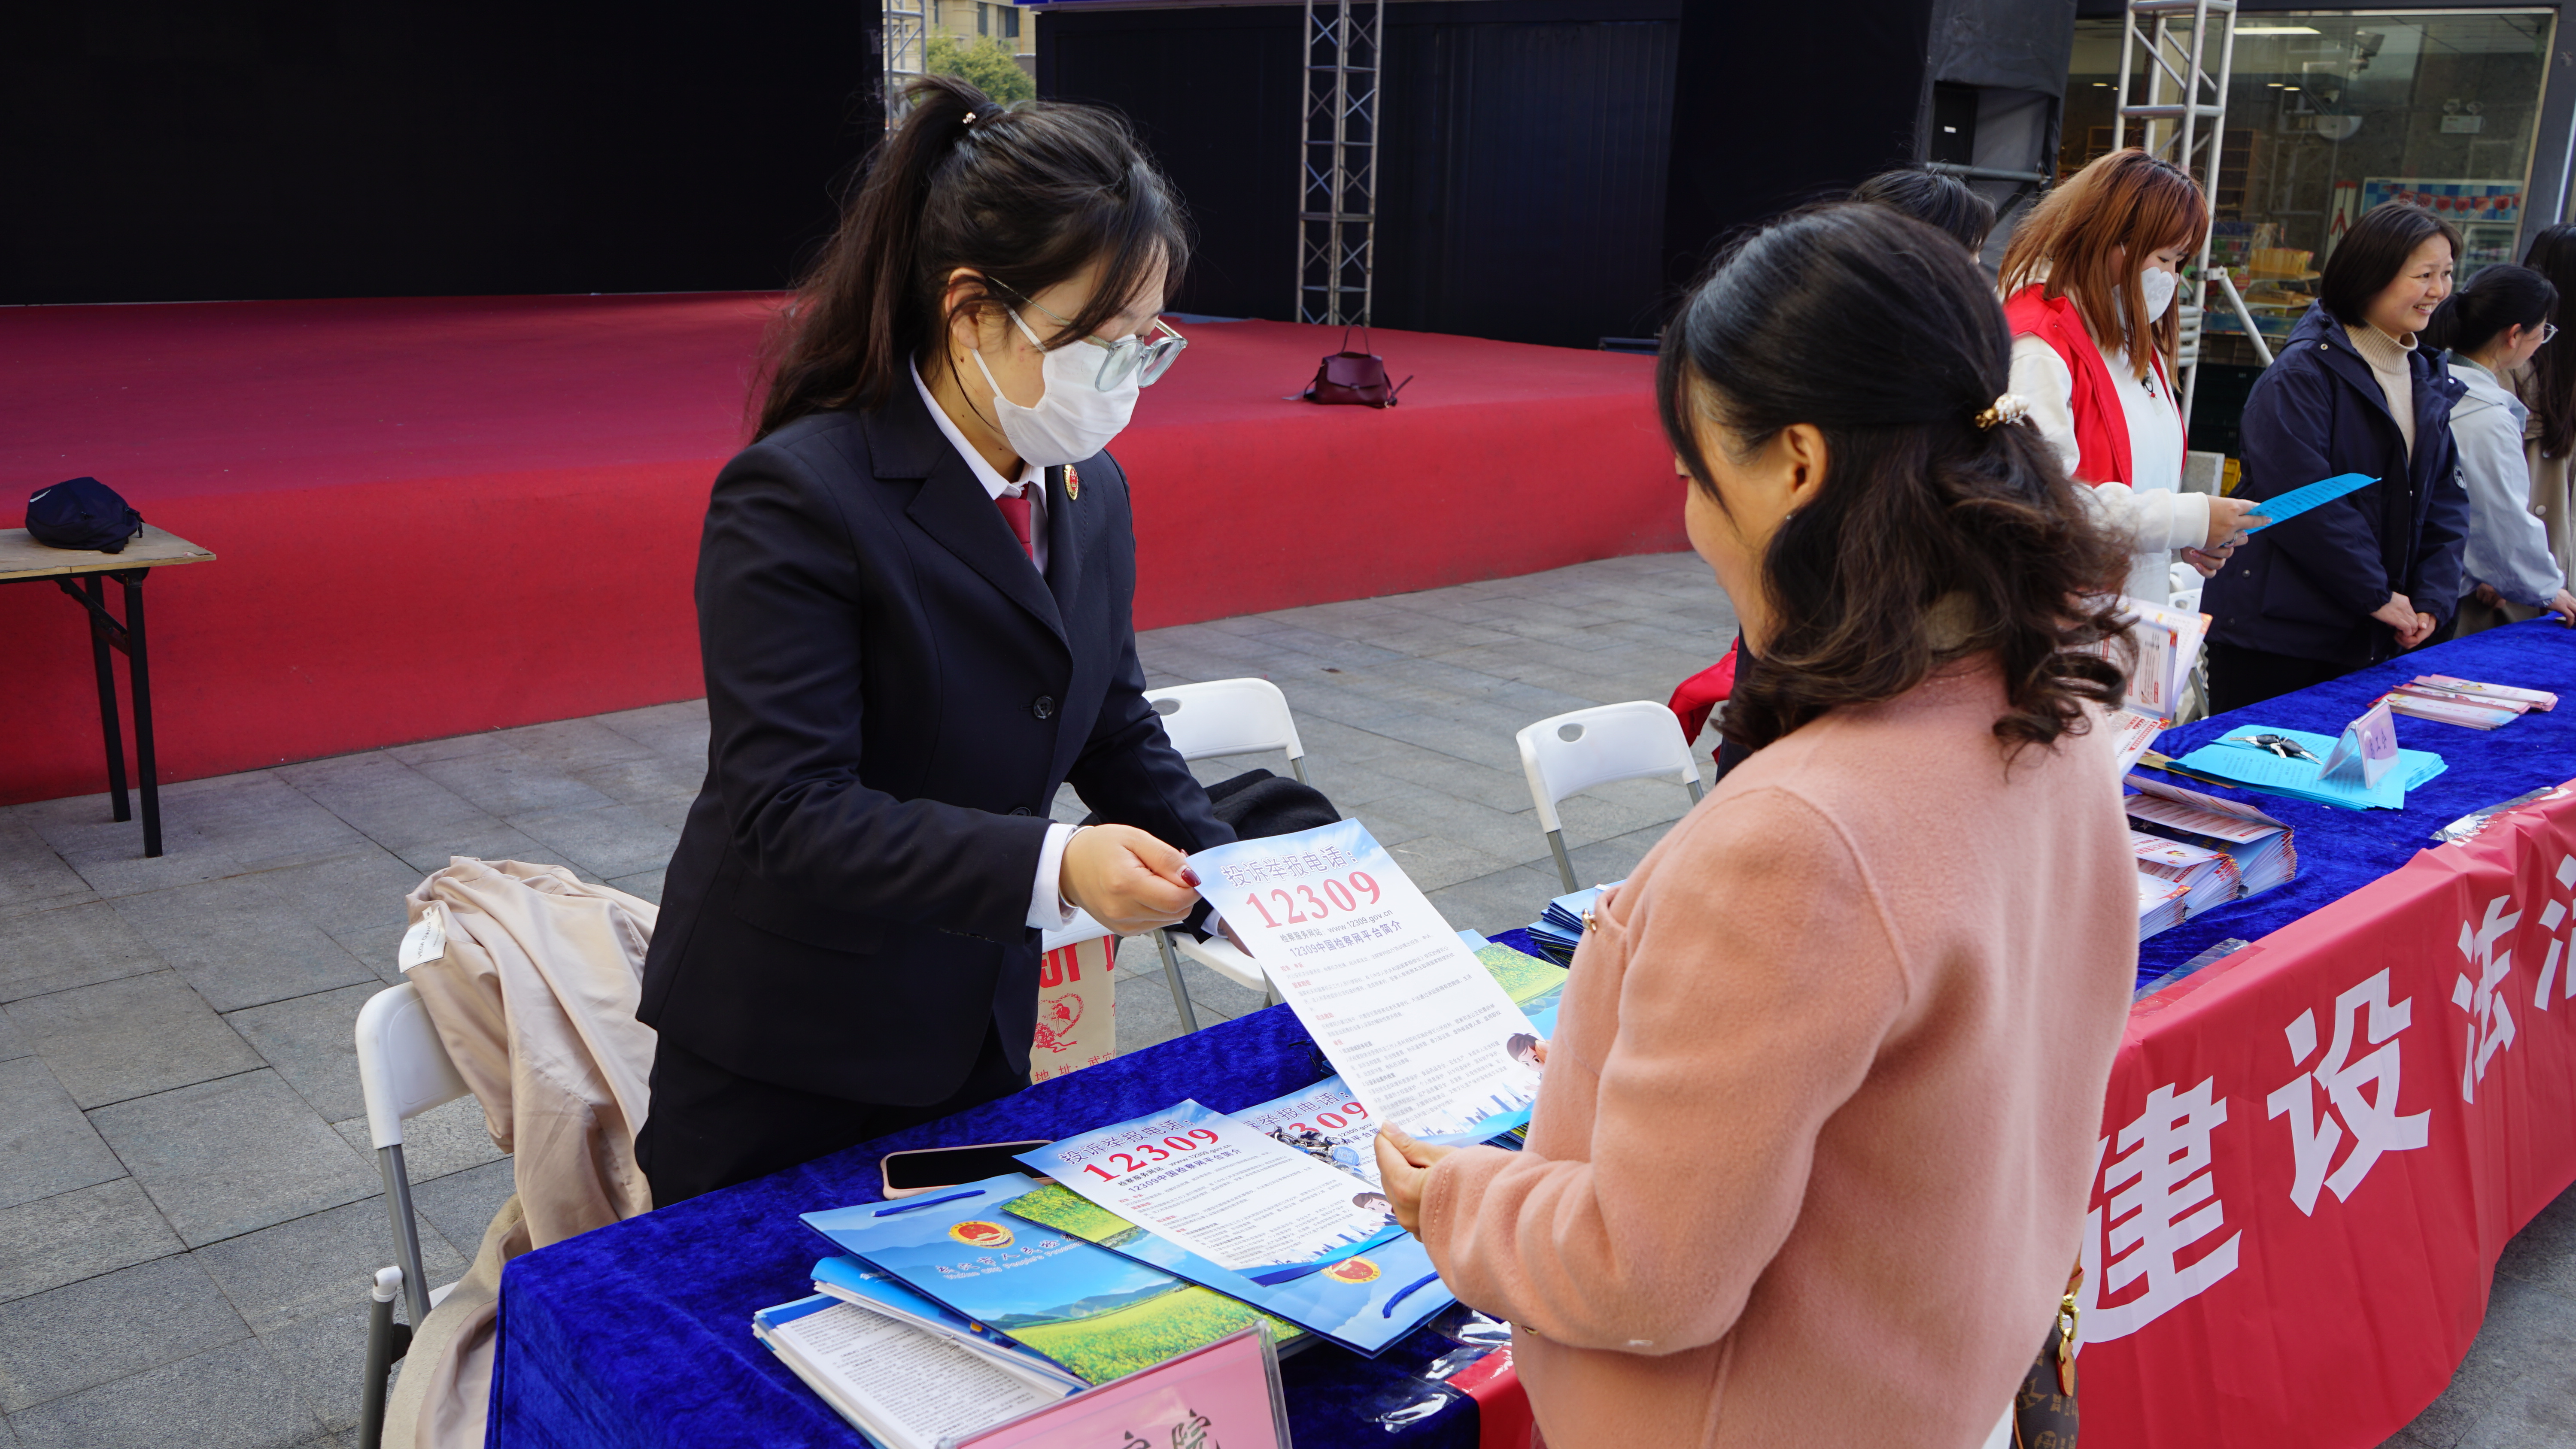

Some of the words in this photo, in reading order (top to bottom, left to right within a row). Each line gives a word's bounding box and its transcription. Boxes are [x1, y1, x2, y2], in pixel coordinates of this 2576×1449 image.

[1220, 844, 1358, 888] 投诉举报电话：
[1246, 871, 1381, 928] 12309
[1279, 928, 1326, 943] 检察服务网站：
[1326, 909, 1394, 934] www.12309.gov.cn
[1288, 919, 1404, 958] 12309中国检察网平台简介
[1058, 1119, 1196, 1165] 投诉举报电话：
[1083, 1128, 1219, 1182] 12309
[1167, 1143, 1233, 1167] www.12309.gov.cn
[1127, 1148, 1243, 1192] 12309中国检察网平台简介
